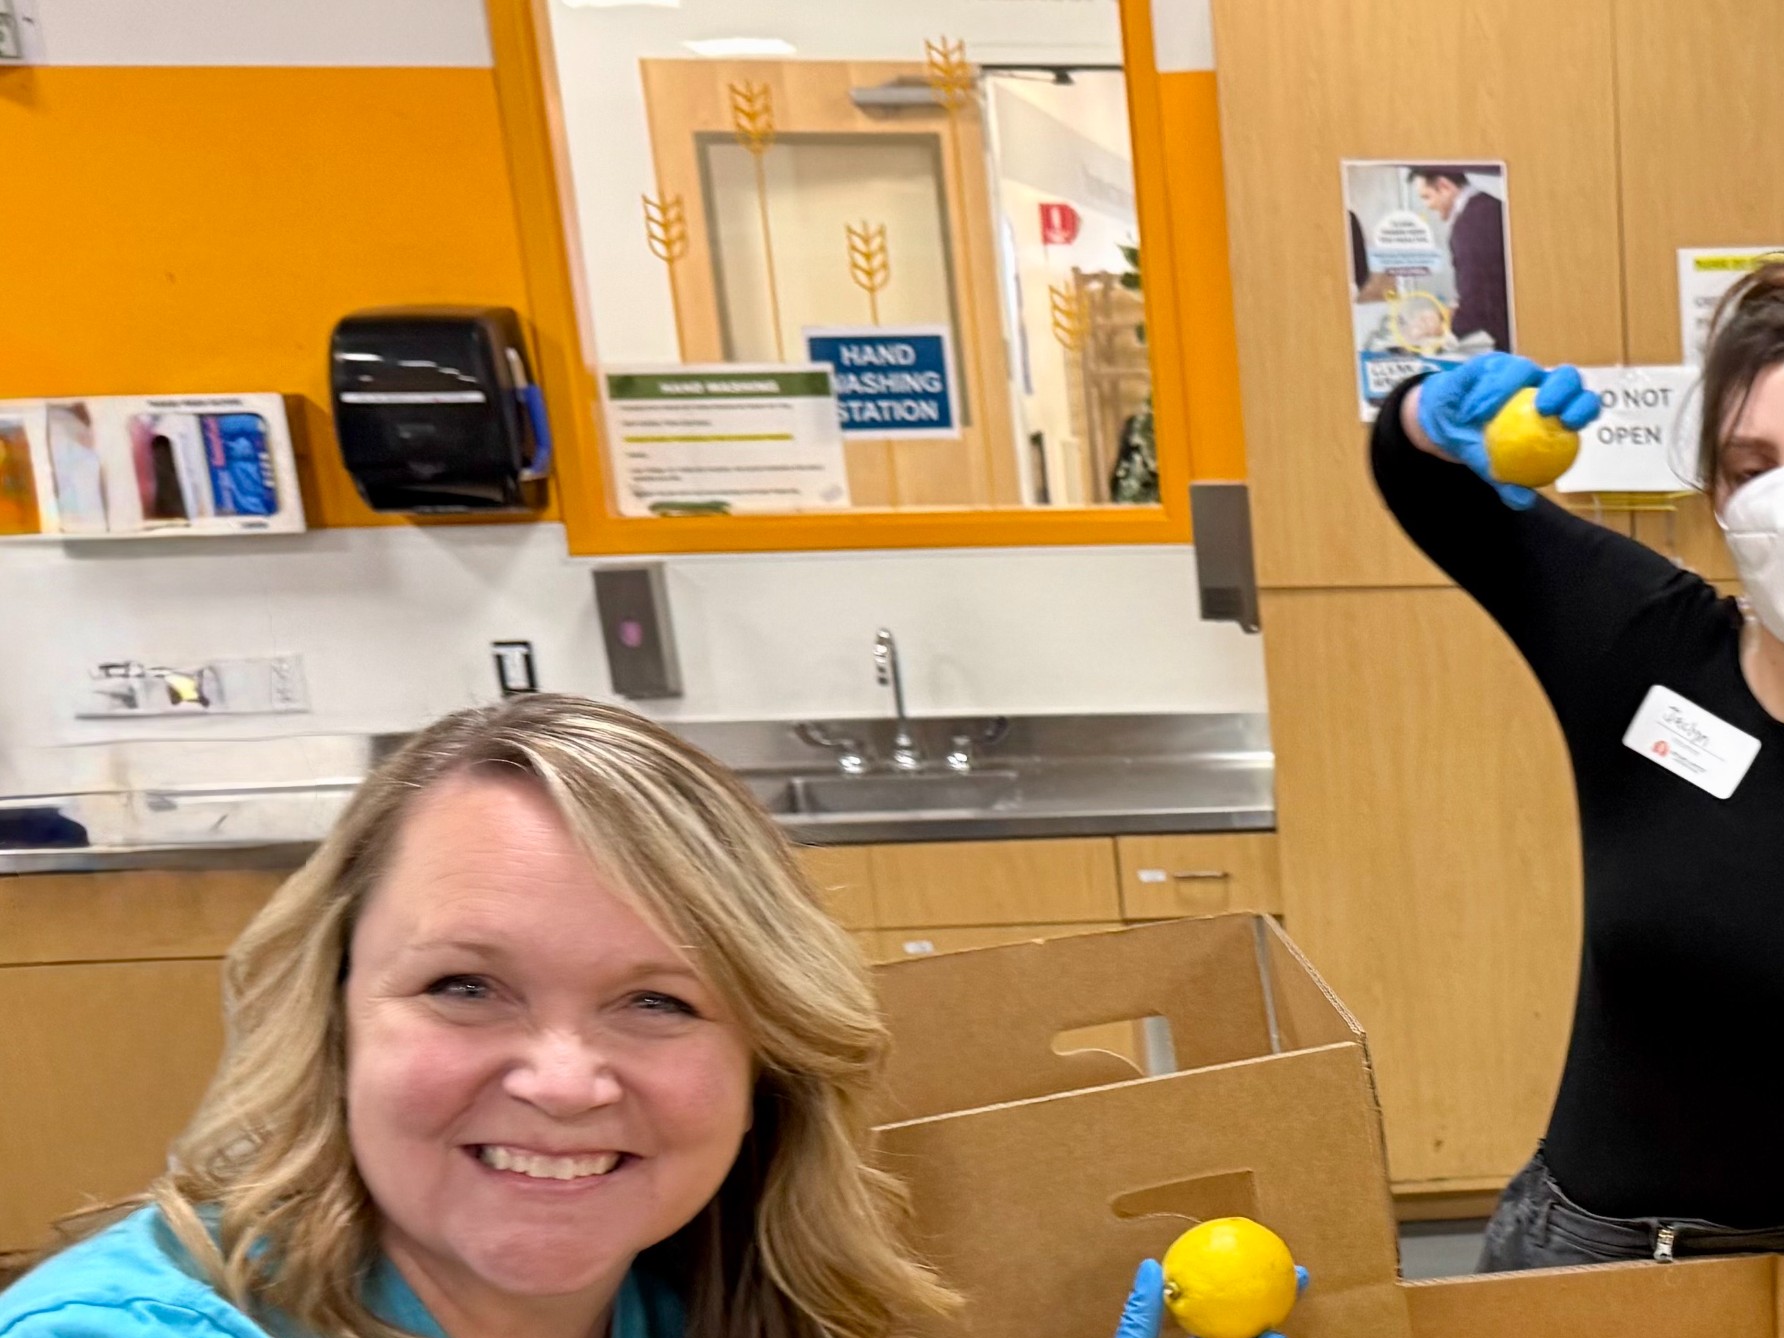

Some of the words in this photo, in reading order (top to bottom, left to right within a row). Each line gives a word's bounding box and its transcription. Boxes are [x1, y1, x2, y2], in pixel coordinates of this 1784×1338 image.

[839, 342, 917, 367] HAND
[1622, 387, 1673, 408] NOT
[1597, 425, 1663, 445] OPEN
